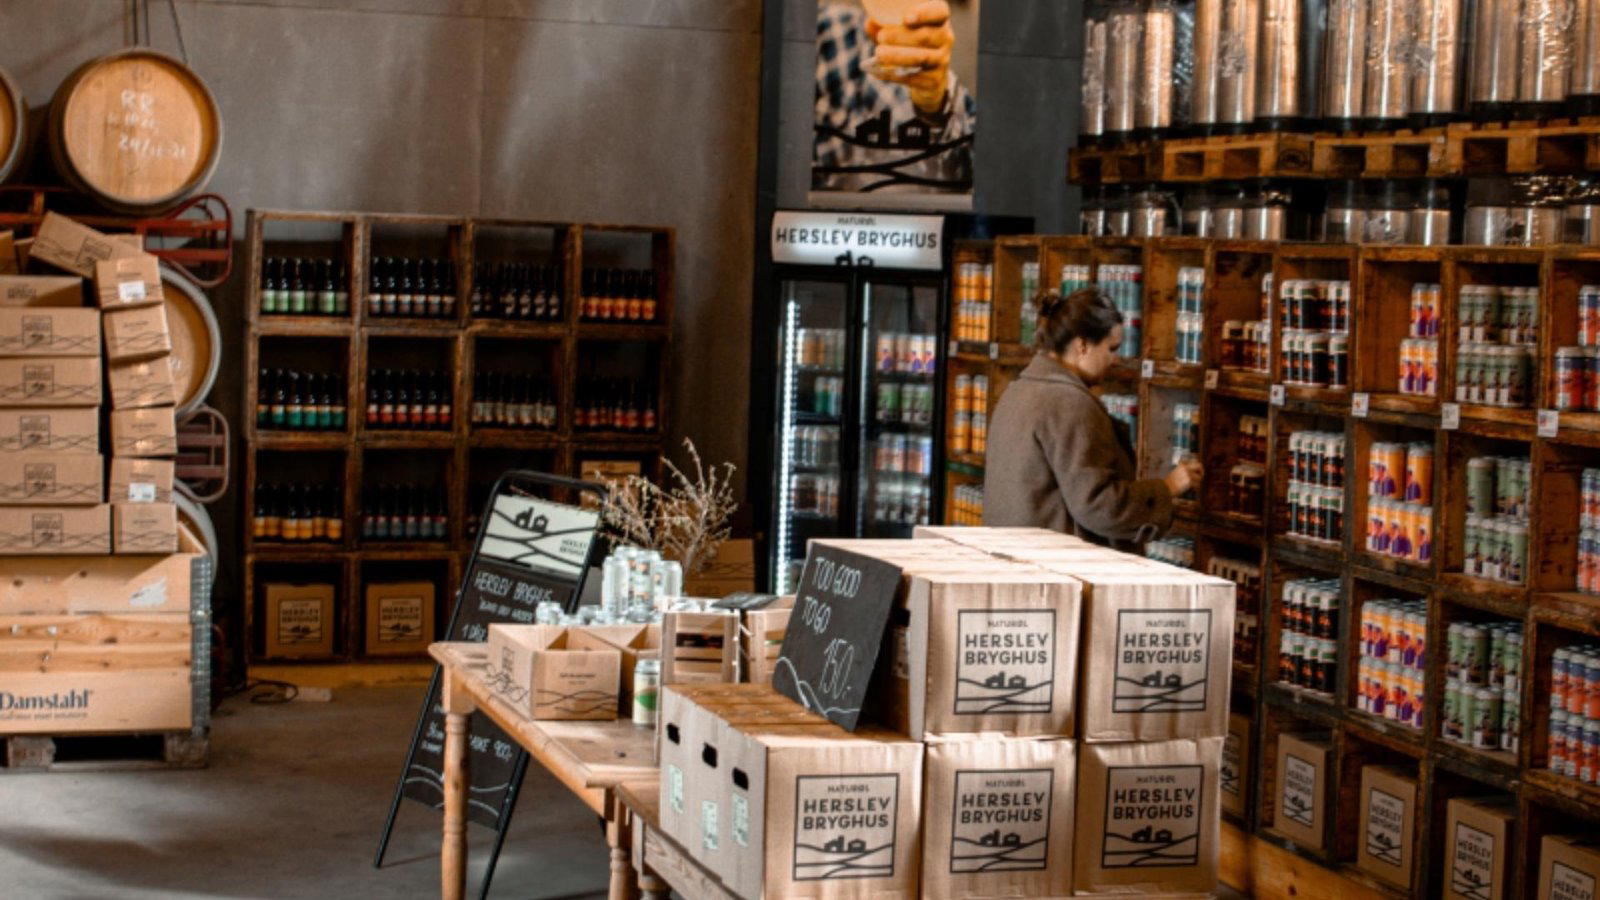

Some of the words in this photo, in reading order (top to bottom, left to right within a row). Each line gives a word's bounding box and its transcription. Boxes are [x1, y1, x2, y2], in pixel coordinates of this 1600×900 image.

[776, 228, 854, 245] HERSLEV
[857, 231, 937, 248] BRYGHUS
[812, 557, 835, 591] TOO
[833, 564, 862, 598] GOOD
[802, 596, 819, 626] TO
[965, 633, 1049, 647] HERSLEV
[1124, 632, 1205, 647] HERSLEV
[964, 649, 1048, 665] BRYGHUS
[1123, 649, 1202, 664] BRYGHUS
[961, 792, 1045, 808] HERSLEV
[1114, 788, 1196, 804] HERSLEV
[803, 797, 892, 814] HERSLEV
[1113, 804, 1194, 820] BRYGHUS
[803, 814, 890, 830] BRYGHUS
[961, 809, 1044, 824] BRYGHUS
